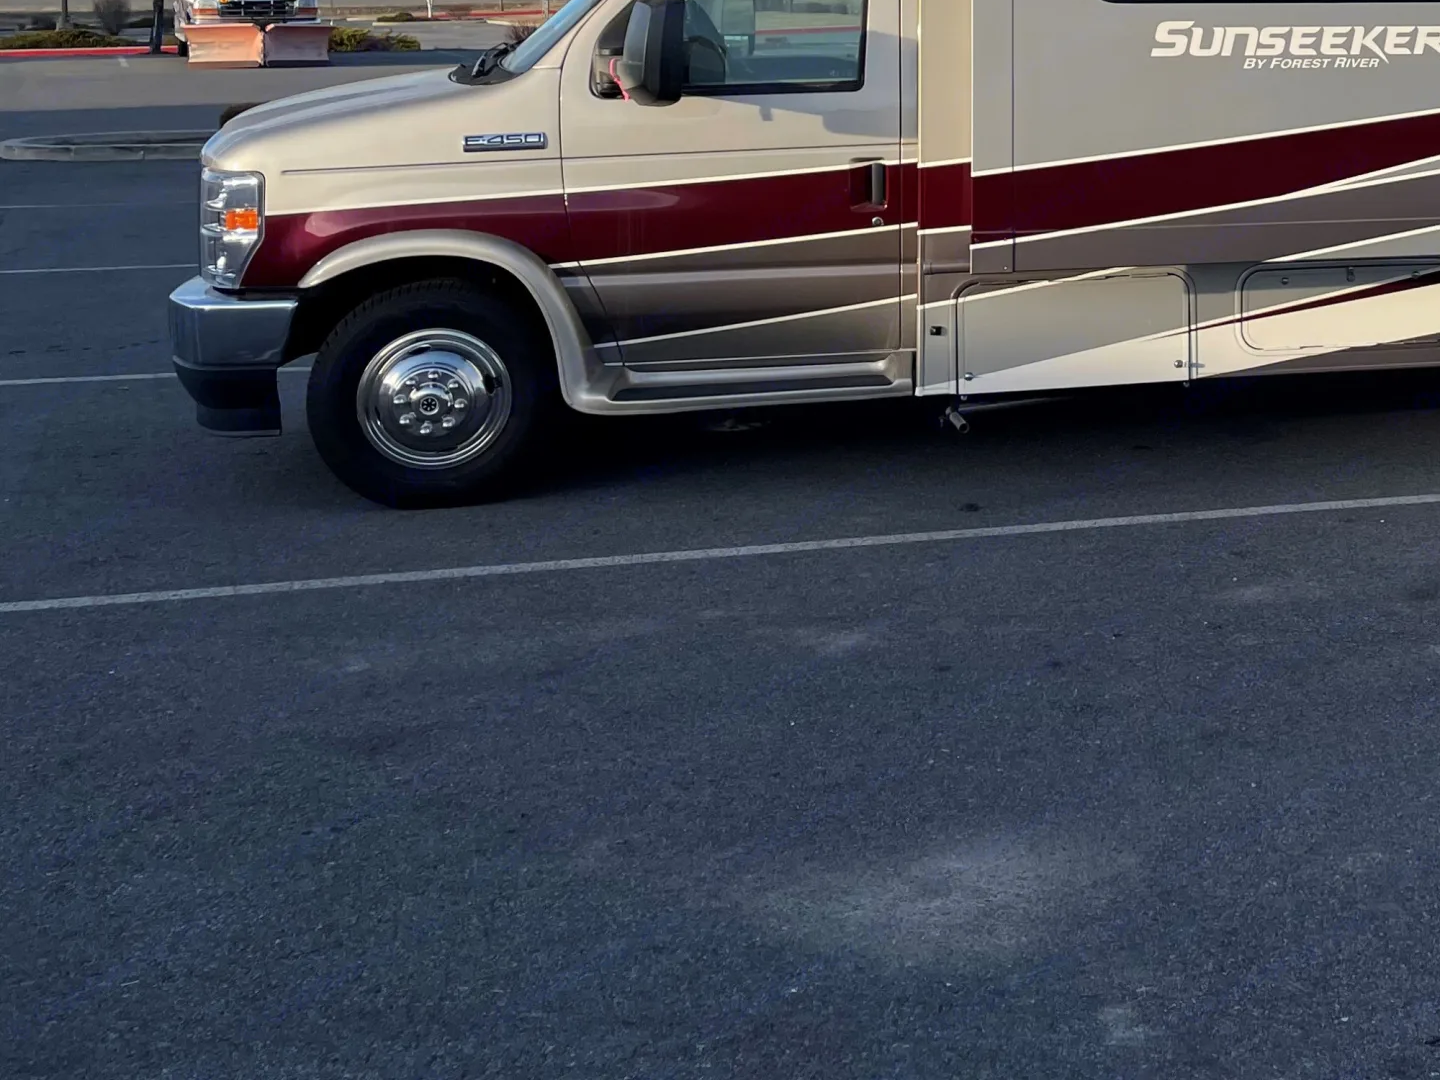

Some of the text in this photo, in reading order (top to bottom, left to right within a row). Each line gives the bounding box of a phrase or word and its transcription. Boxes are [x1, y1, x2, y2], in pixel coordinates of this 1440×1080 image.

[1243, 57, 1379, 69] BY FOREST RIVER
[464, 133, 542, 146] E-450
